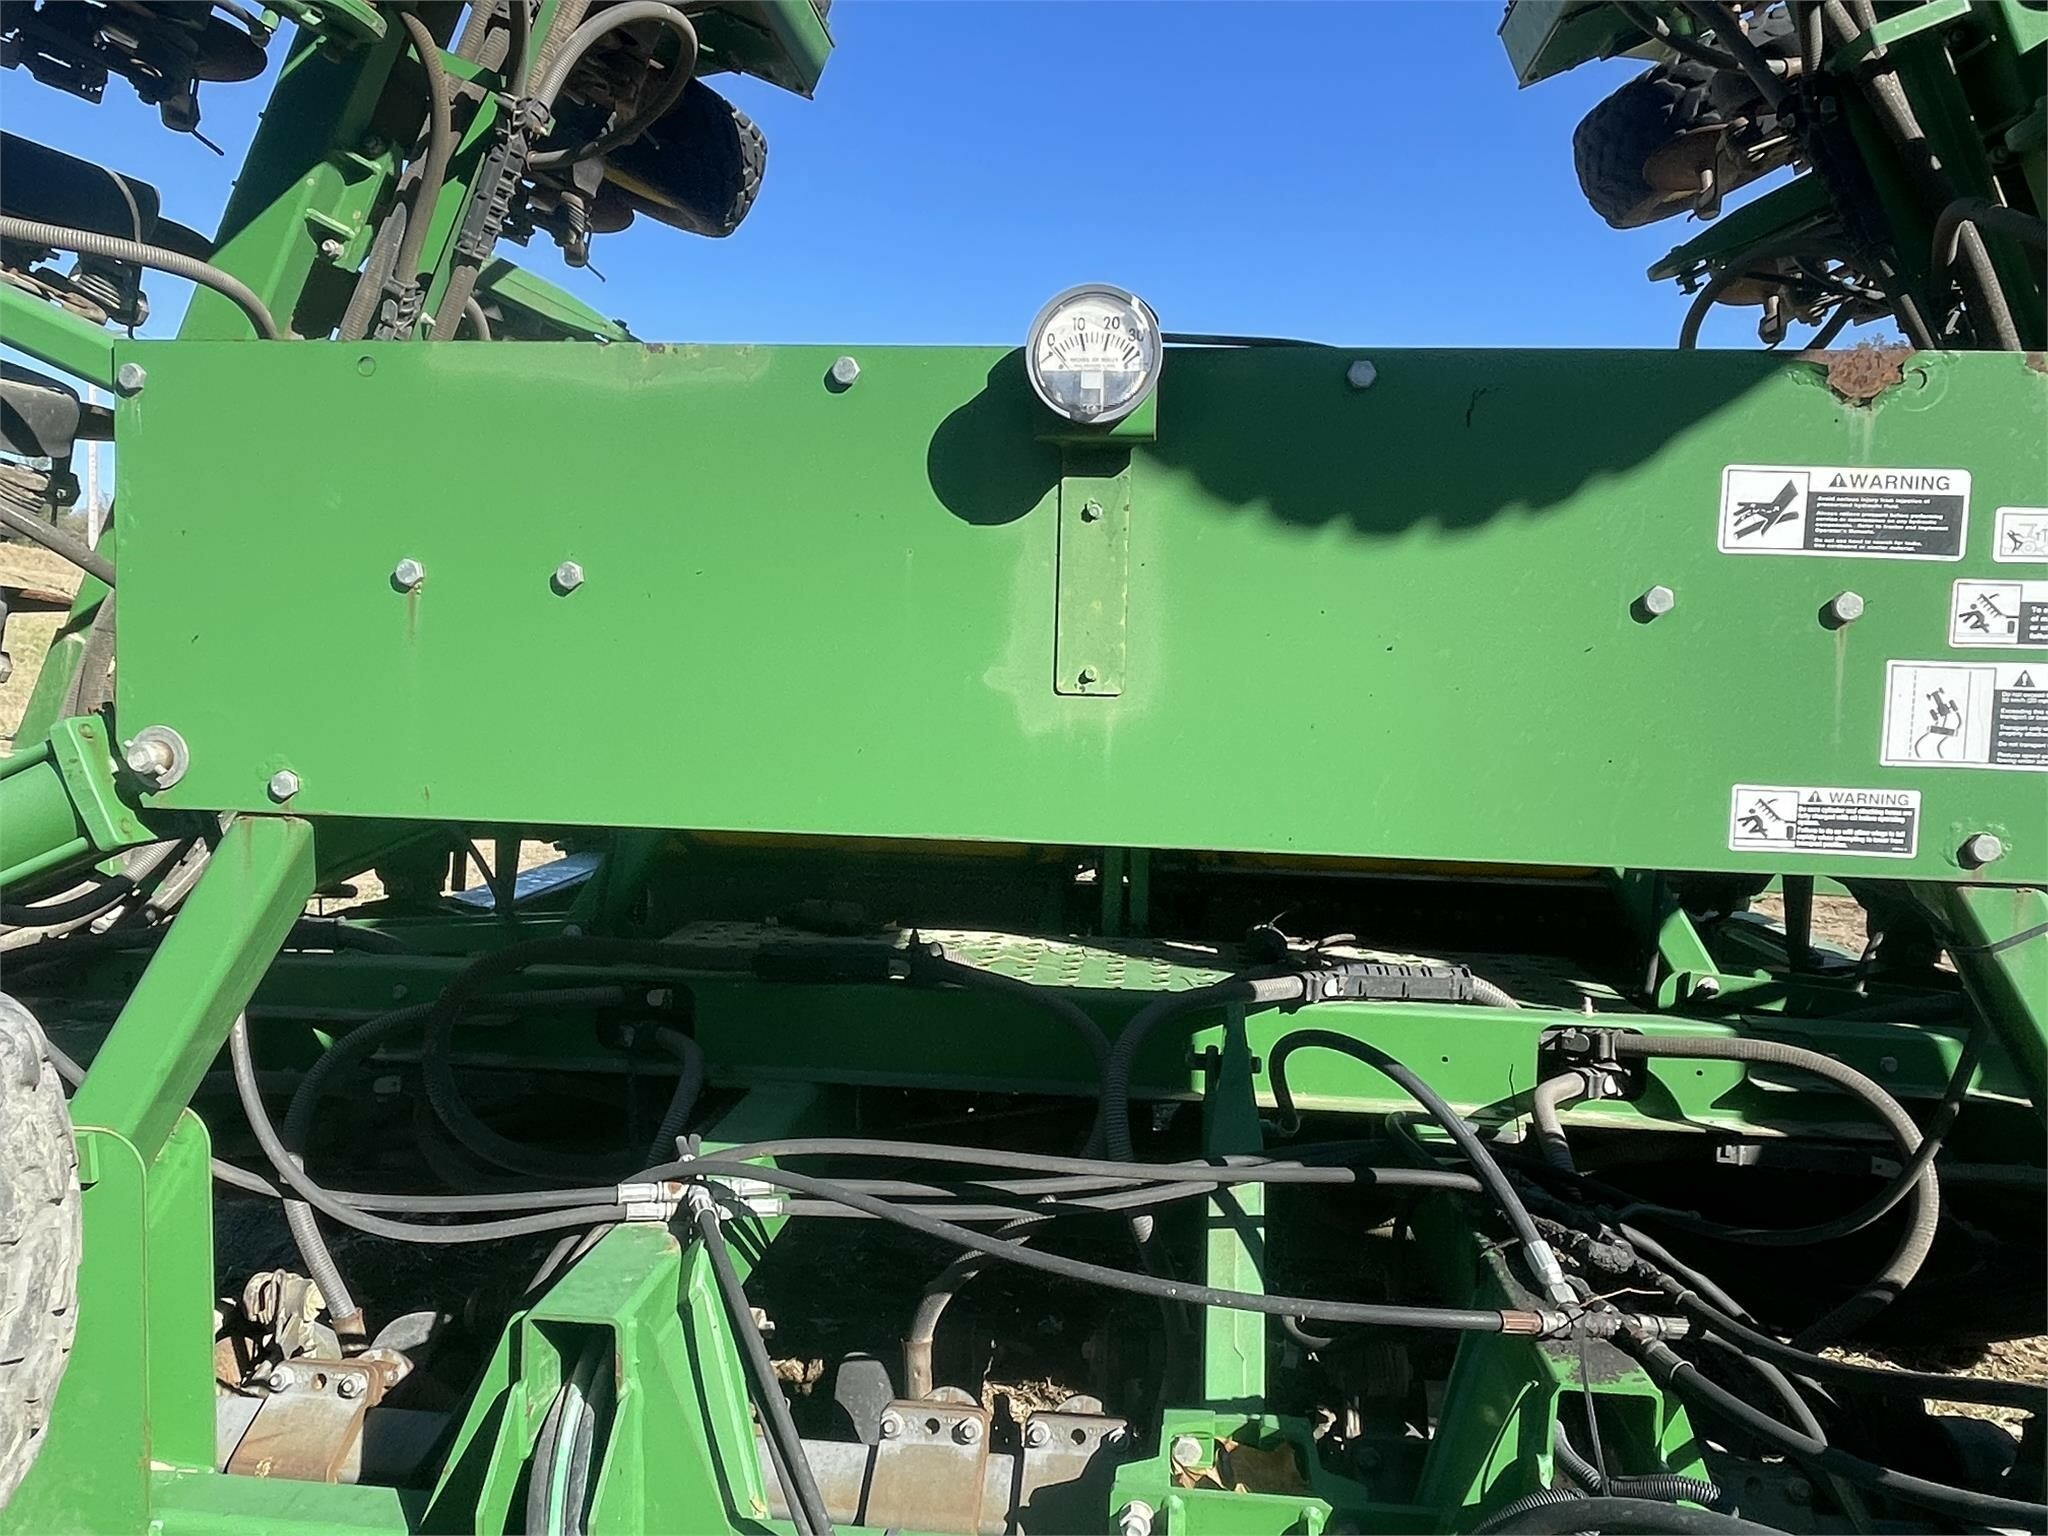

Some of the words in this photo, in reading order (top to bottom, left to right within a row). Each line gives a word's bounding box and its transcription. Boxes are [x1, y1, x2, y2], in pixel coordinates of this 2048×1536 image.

[1047, 333, 1055, 346] 0
[1073, 317, 1085, 331] 10
[1104, 316, 1120, 330] 20
[1128, 328, 1144, 342] 30
[1850, 474, 1950, 491] WARNING
[2031, 605, 2042, 613] To
[1829, 792, 1909, 806] WARNING
